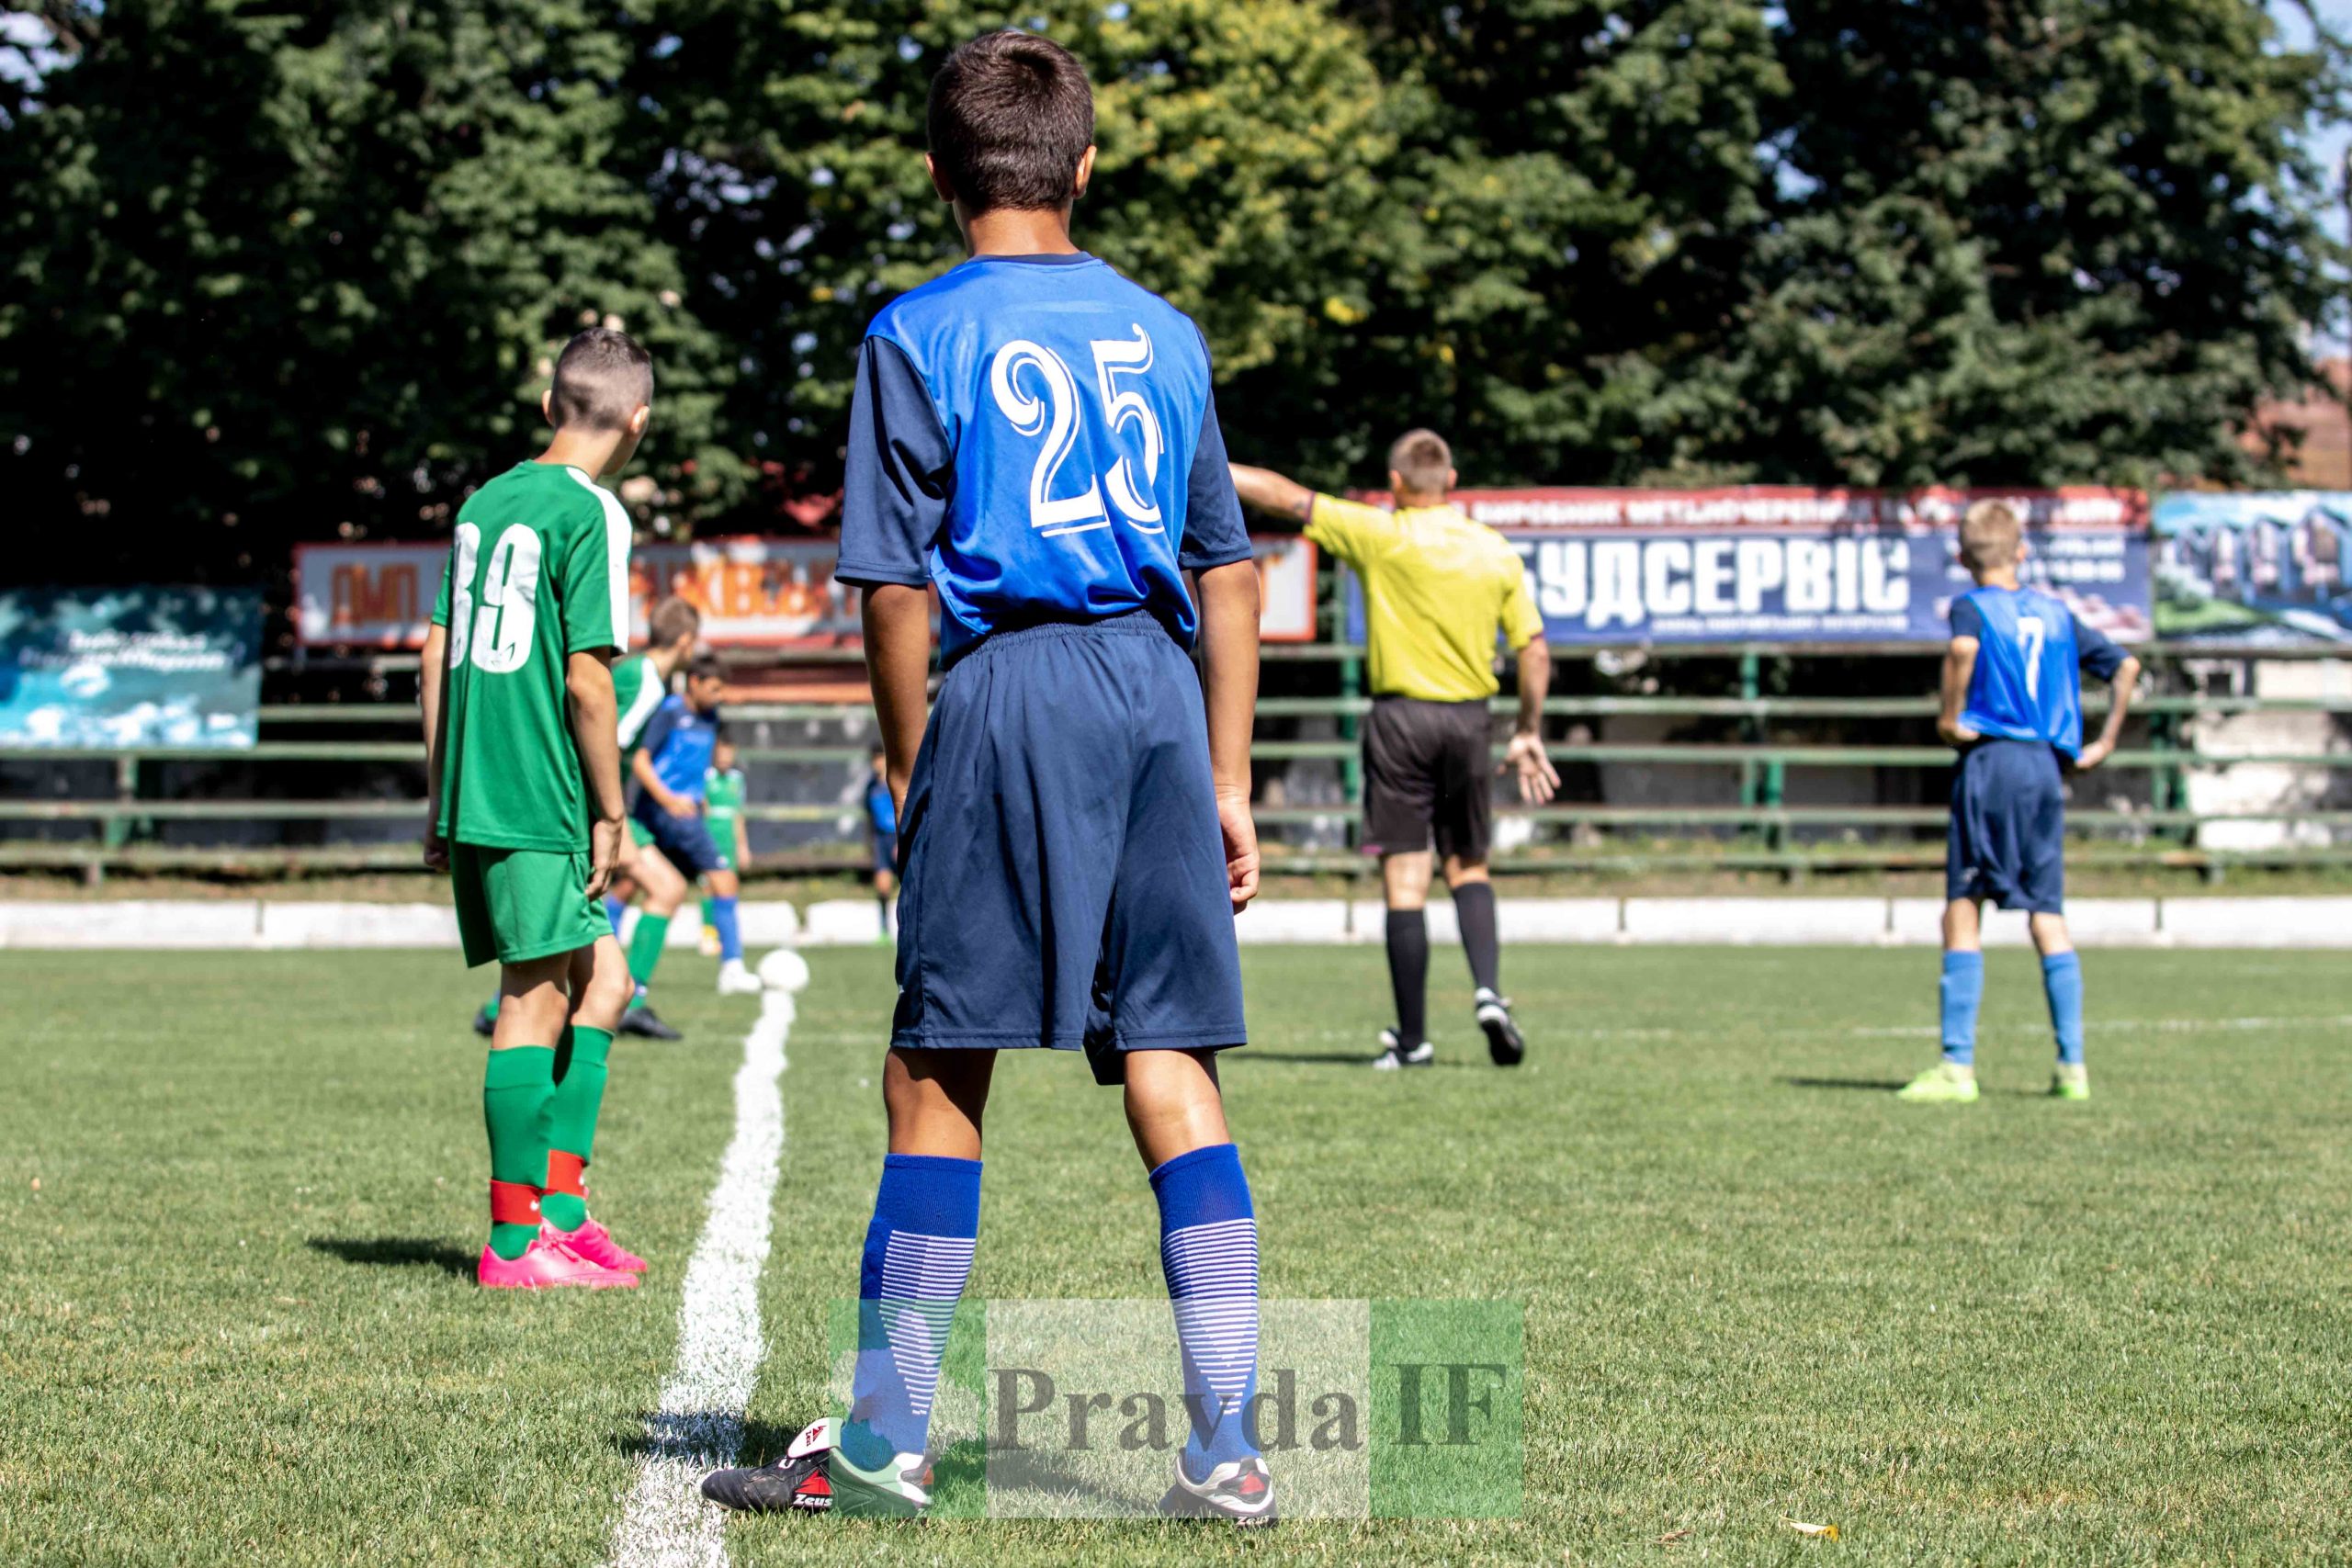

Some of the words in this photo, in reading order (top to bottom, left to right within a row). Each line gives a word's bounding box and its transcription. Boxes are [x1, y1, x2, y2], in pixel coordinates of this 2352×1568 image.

[990, 322, 1165, 537] 25
[2016, 616, 2043, 702] 7
[793, 1494, 832, 1507] Zeus
